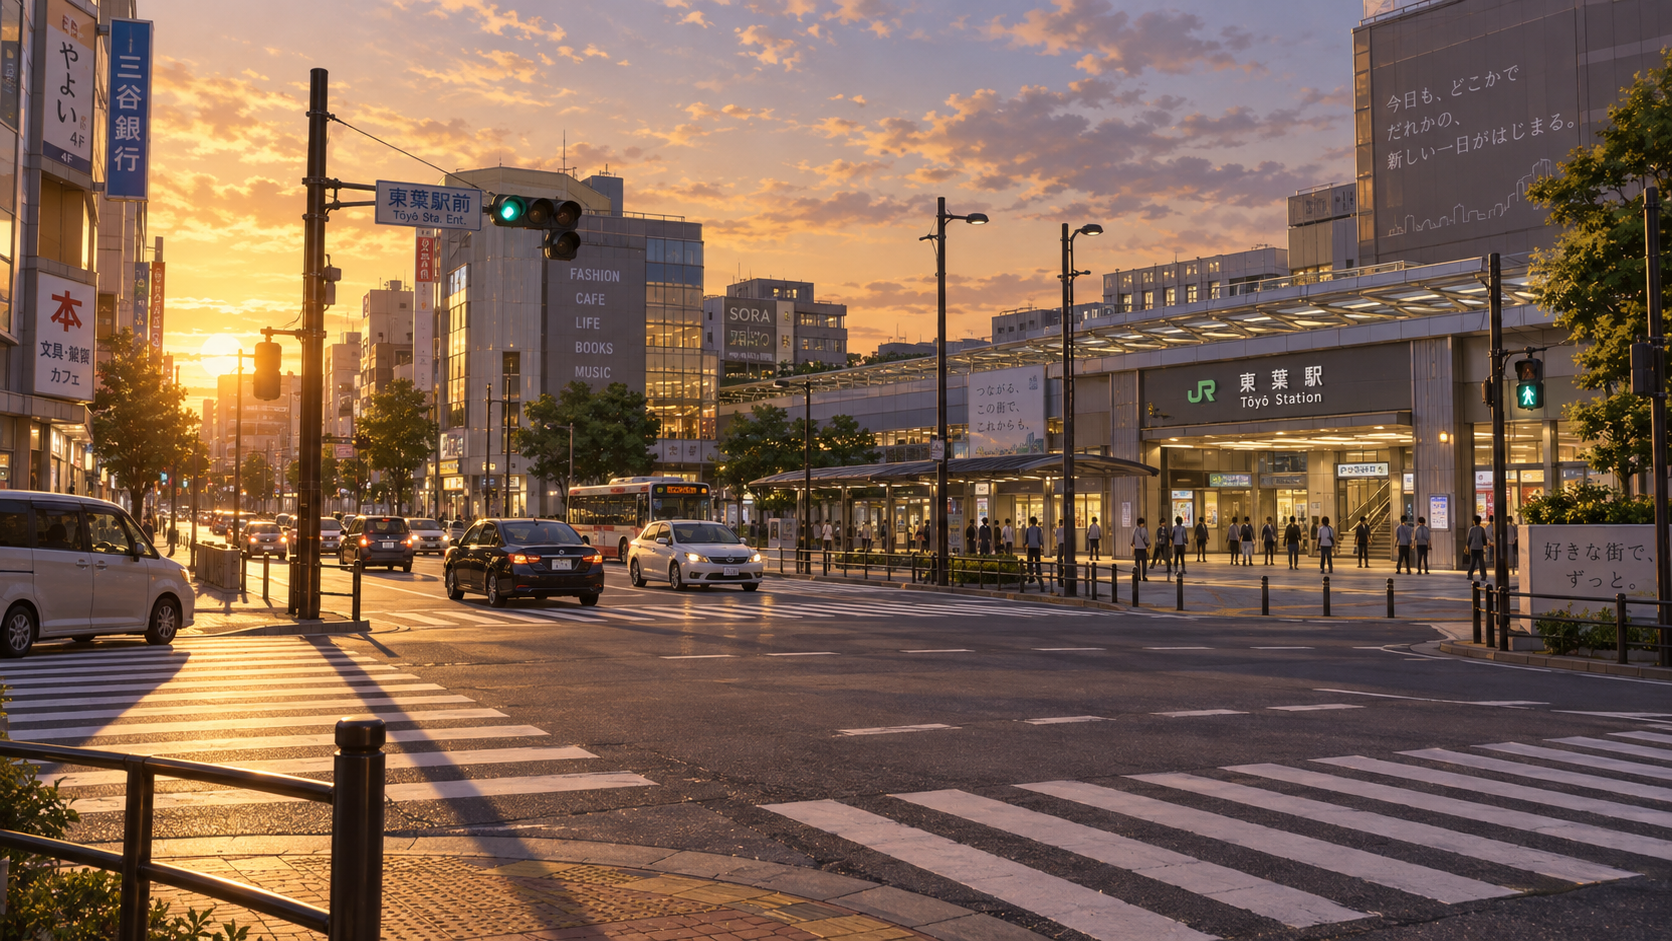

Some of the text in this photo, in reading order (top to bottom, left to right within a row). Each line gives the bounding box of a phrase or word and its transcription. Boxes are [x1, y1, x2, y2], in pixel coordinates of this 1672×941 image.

[57, 41, 79, 123] やよい
[1386, 64, 1519, 113] 今日も、どこかで
[114, 55, 142, 172] 三谷銀行
[1387, 112, 1460, 141] だれかの、
[70, 132, 85, 148] 4F
[1387, 113, 1575, 170] 新しい一日がはじまる。
[61, 152, 73, 163] 4F
[388, 187, 471, 213] 東葉駅前
[422, 212, 442, 223] Sta.
[446, 214, 467, 225] Ent.
[570, 267, 620, 282] FASHION
[575, 292, 605, 306] CAFE
[50, 290, 82, 333] 本
[730, 307, 770, 323] SORA
[575, 316, 600, 330] LIFE
[575, 341, 613, 354] BOOKS
[51, 367, 80, 386] カフェ
[575, 366, 611, 379] MUSIC
[1240, 365, 1323, 392] 東葉駅
[1187, 379, 1216, 403] JR
[1275, 392, 1322, 405] Station
[1544, 542, 1653, 562] 好きな街で、
[1566, 570, 1636, 590] ずっと。
